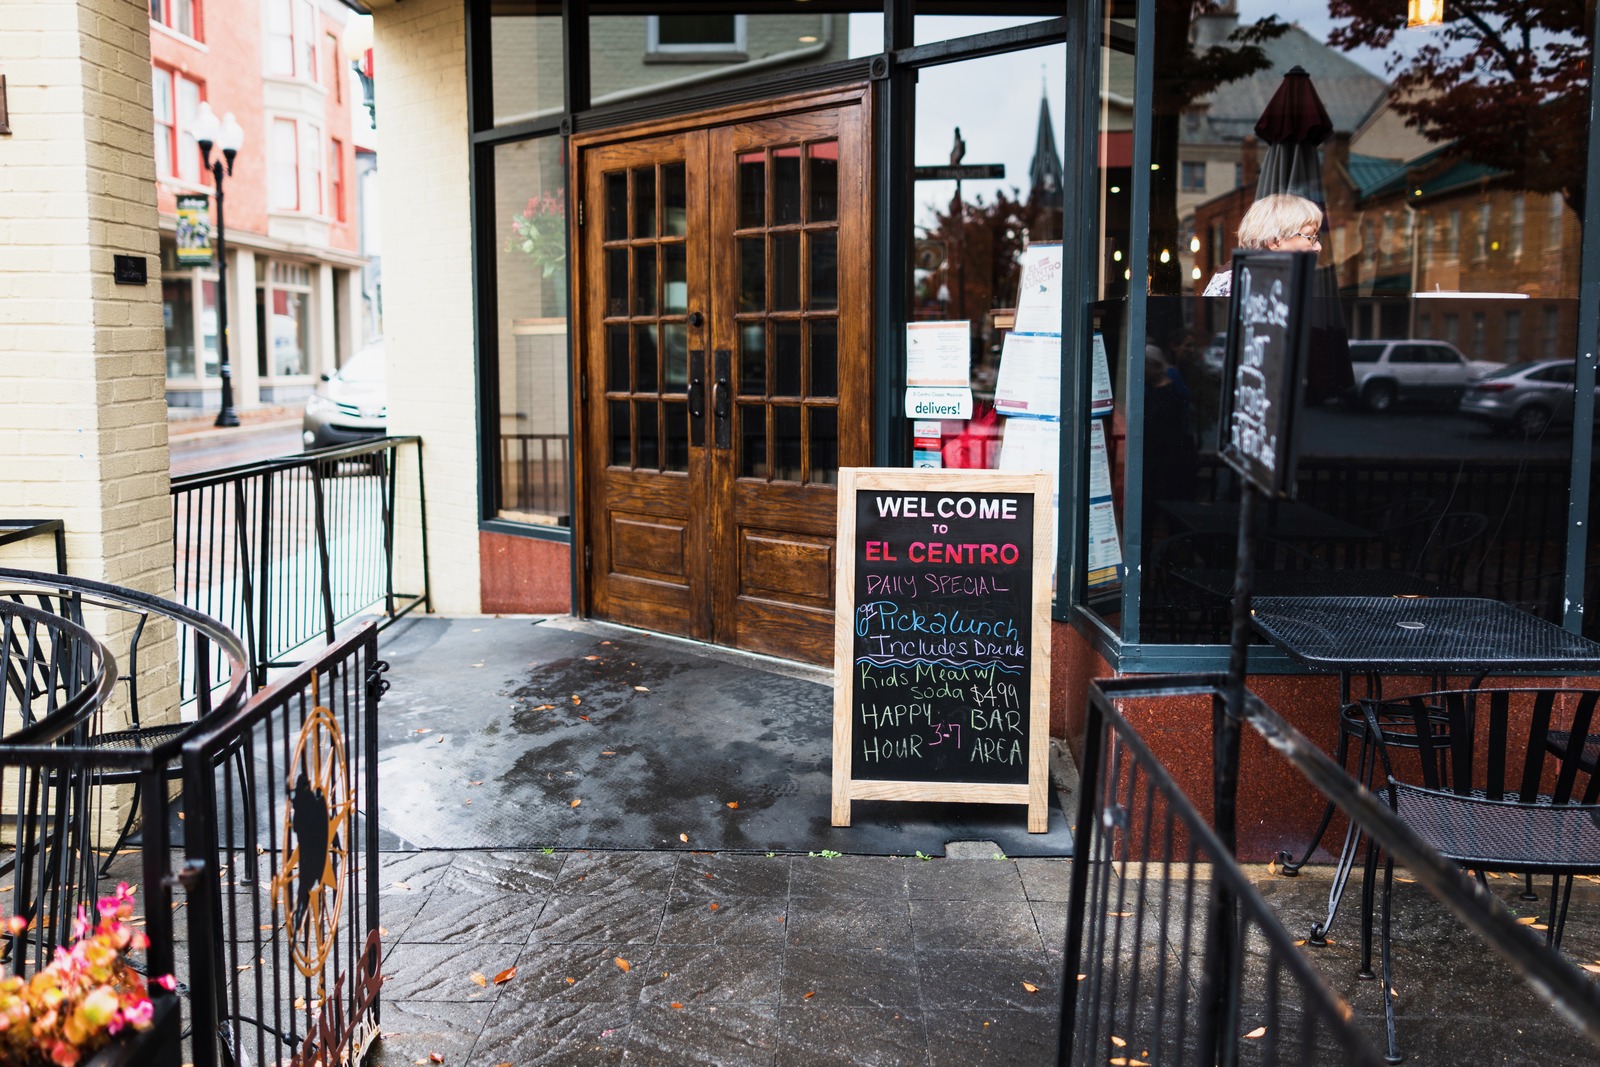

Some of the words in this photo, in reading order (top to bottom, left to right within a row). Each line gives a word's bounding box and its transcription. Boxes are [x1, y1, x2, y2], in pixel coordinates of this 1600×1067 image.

[915, 402, 960, 415] delivers!
[876, 496, 1017, 519] WELCOME
[932, 524, 948, 534] TO
[865, 541, 897, 561] EL
[908, 542, 1019, 565] CENTRO
[924, 573, 1010, 597] SPECIAL
[868, 633, 968, 658] Includes
[861, 663, 908, 689] Kids
[916, 662, 970, 684] Meal
[861, 703, 932, 729] HAPPY
[971, 708, 1024, 735] BAR
[863, 734, 923, 763] HOUR
[928, 723, 961, 749] 3-7
[970, 737, 1023, 766] AREA
